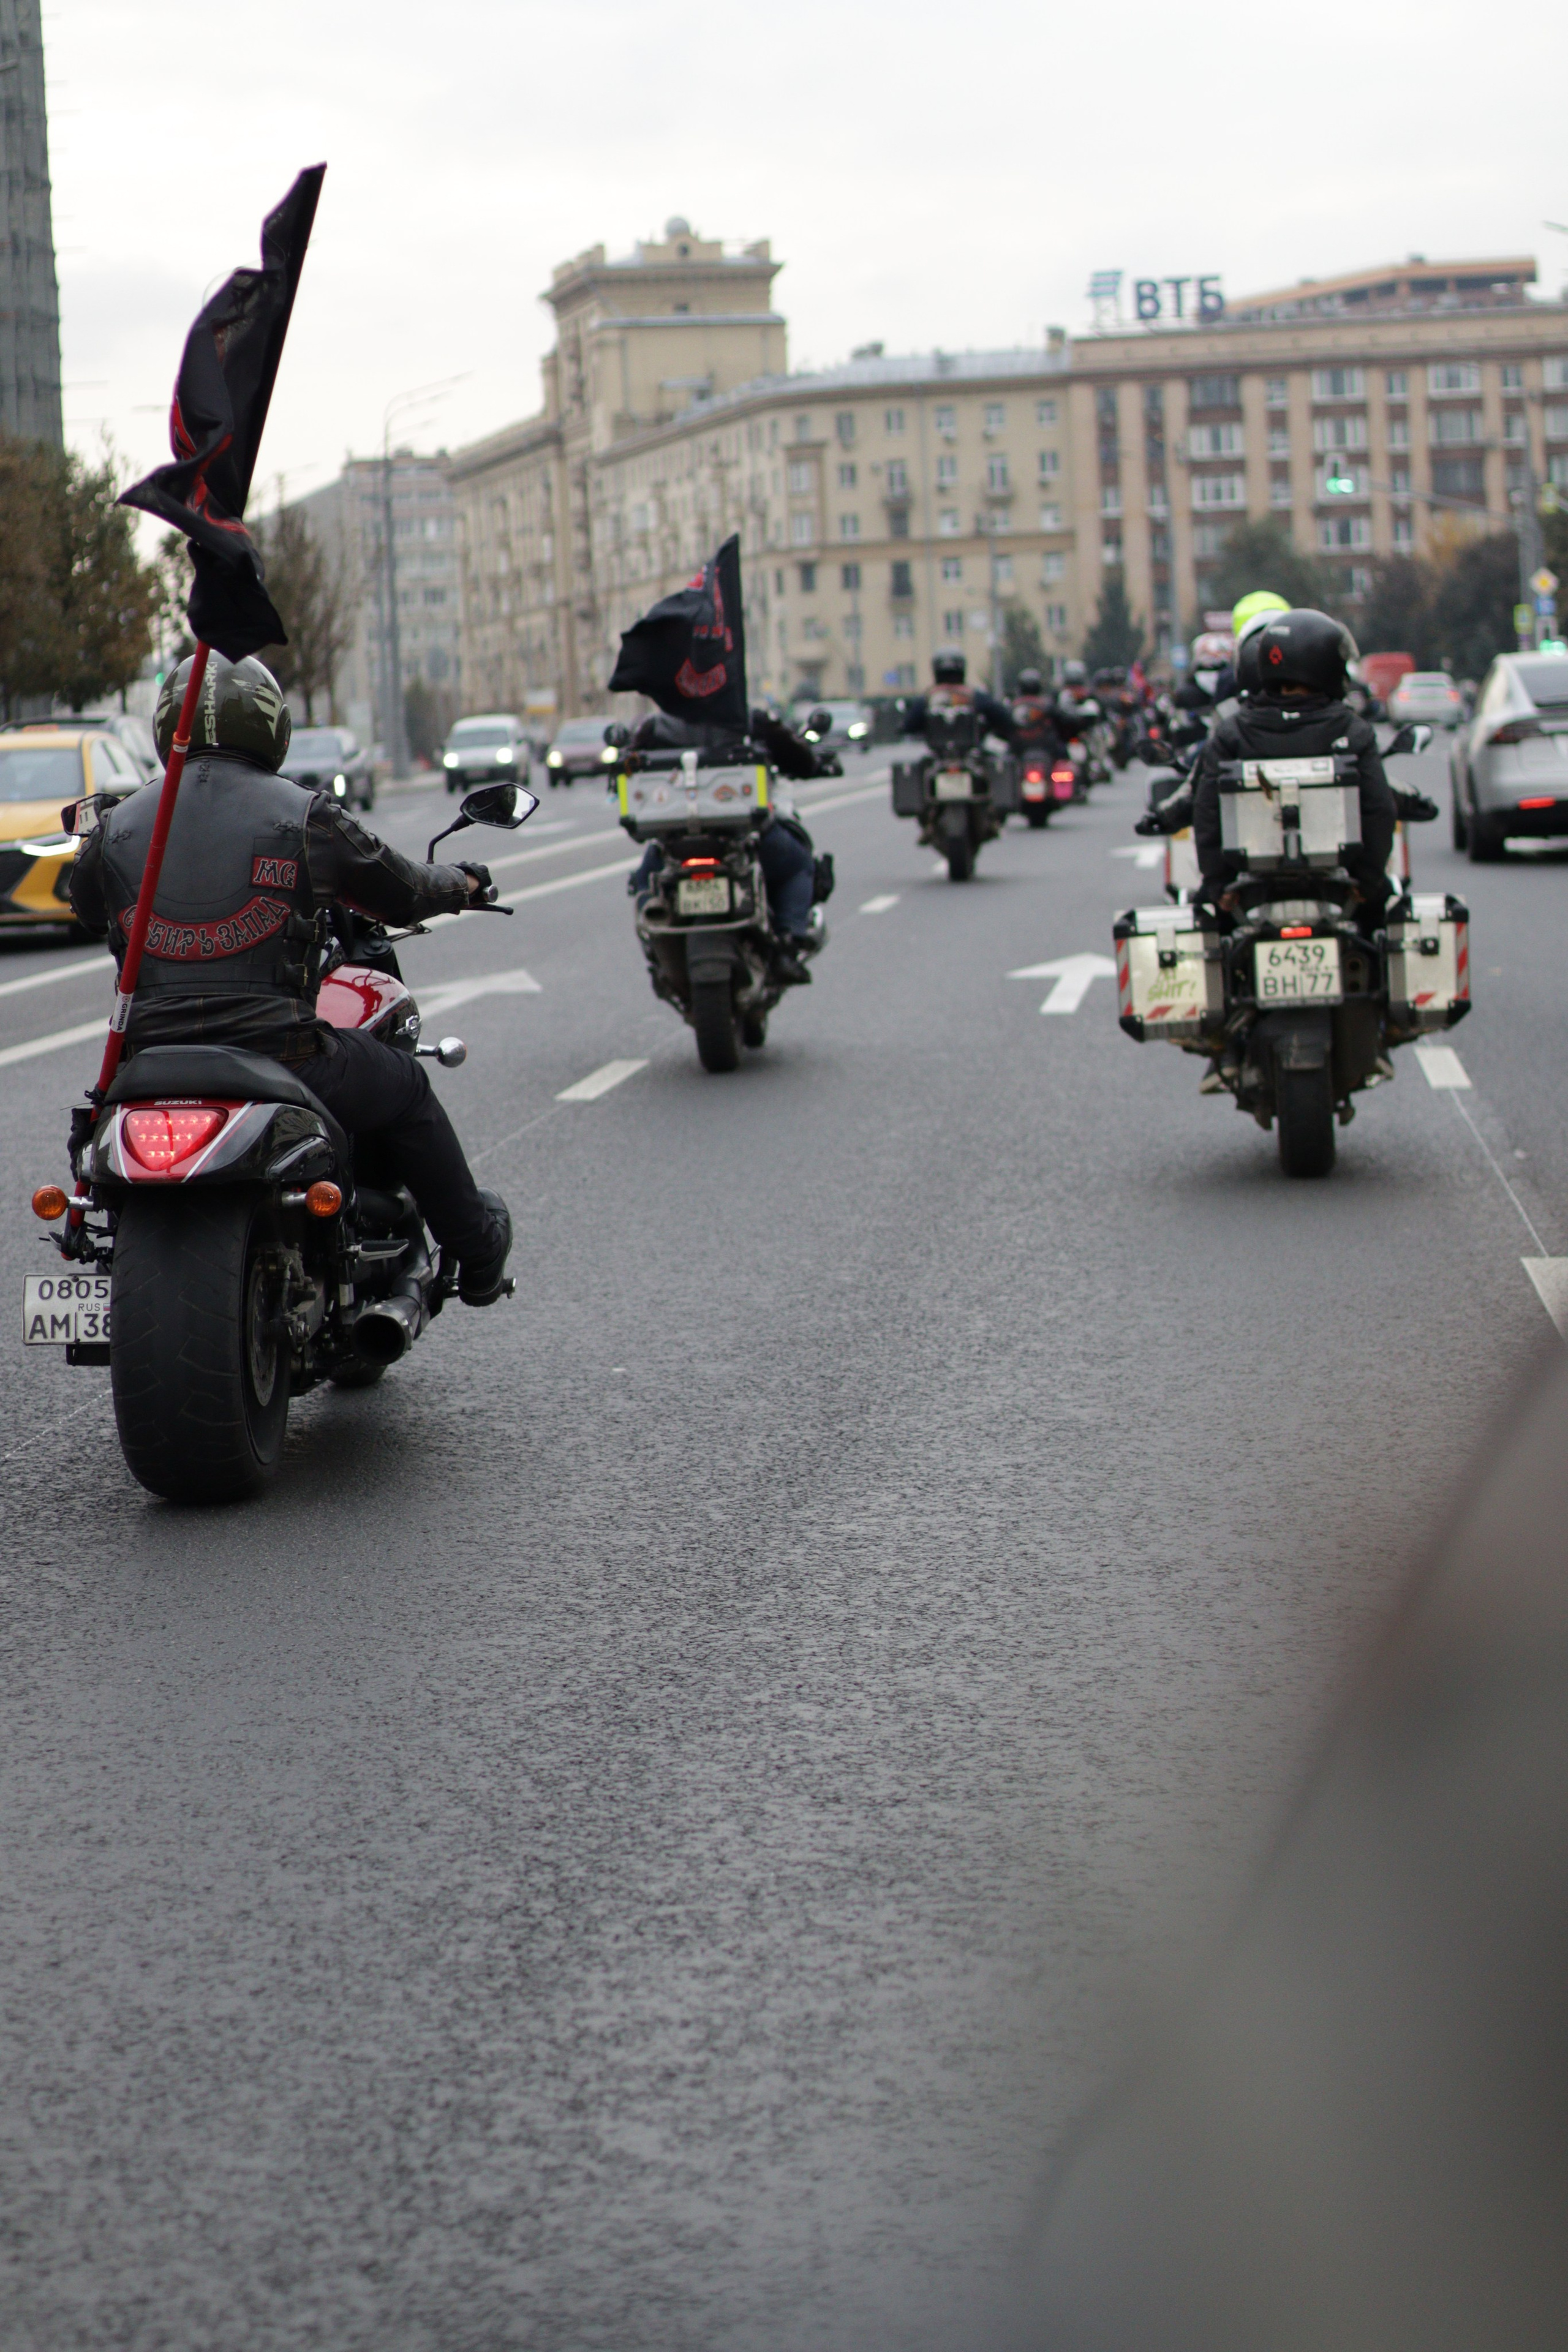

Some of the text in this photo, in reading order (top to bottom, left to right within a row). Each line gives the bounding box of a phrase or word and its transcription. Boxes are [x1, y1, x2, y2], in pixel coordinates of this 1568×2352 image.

[1136, 276, 1224, 320] ВТБ
[123, 896, 291, 956] СБИРЬ-ЗАПАД
[1268, 944, 1325, 967] 6439
[1306, 973, 1333, 993] 77
[116, 1003, 128, 1031] GRINDA
[38, 1280, 108, 1300] 0805
[78, 1303, 100, 1311] RUS
